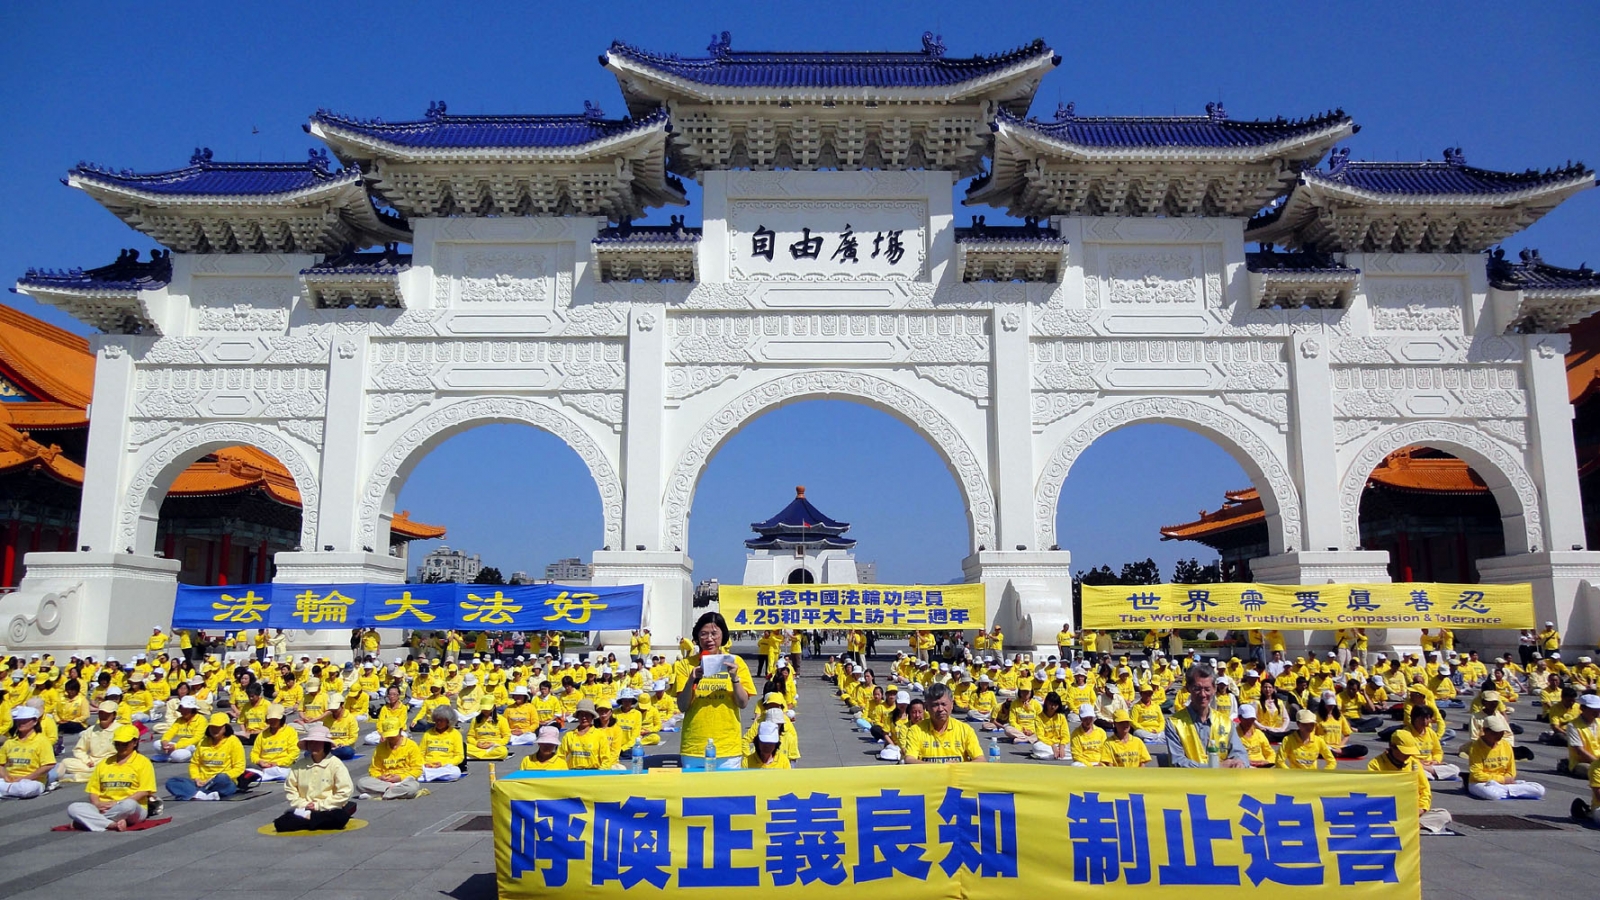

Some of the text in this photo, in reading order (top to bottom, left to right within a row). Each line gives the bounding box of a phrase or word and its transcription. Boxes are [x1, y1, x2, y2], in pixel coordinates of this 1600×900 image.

[757, 590, 943, 606] 紀念中國法輪功學員
[212, 590, 608, 624] 法輪大法好
[735, 608, 969, 625] 4.25和平大上訪十二週年
[1119, 613, 1502, 625] The World Needs Truthfulness, Compassion & Tolerance
[511, 788, 1402, 888] 呼喚正義良知 制止迫害
